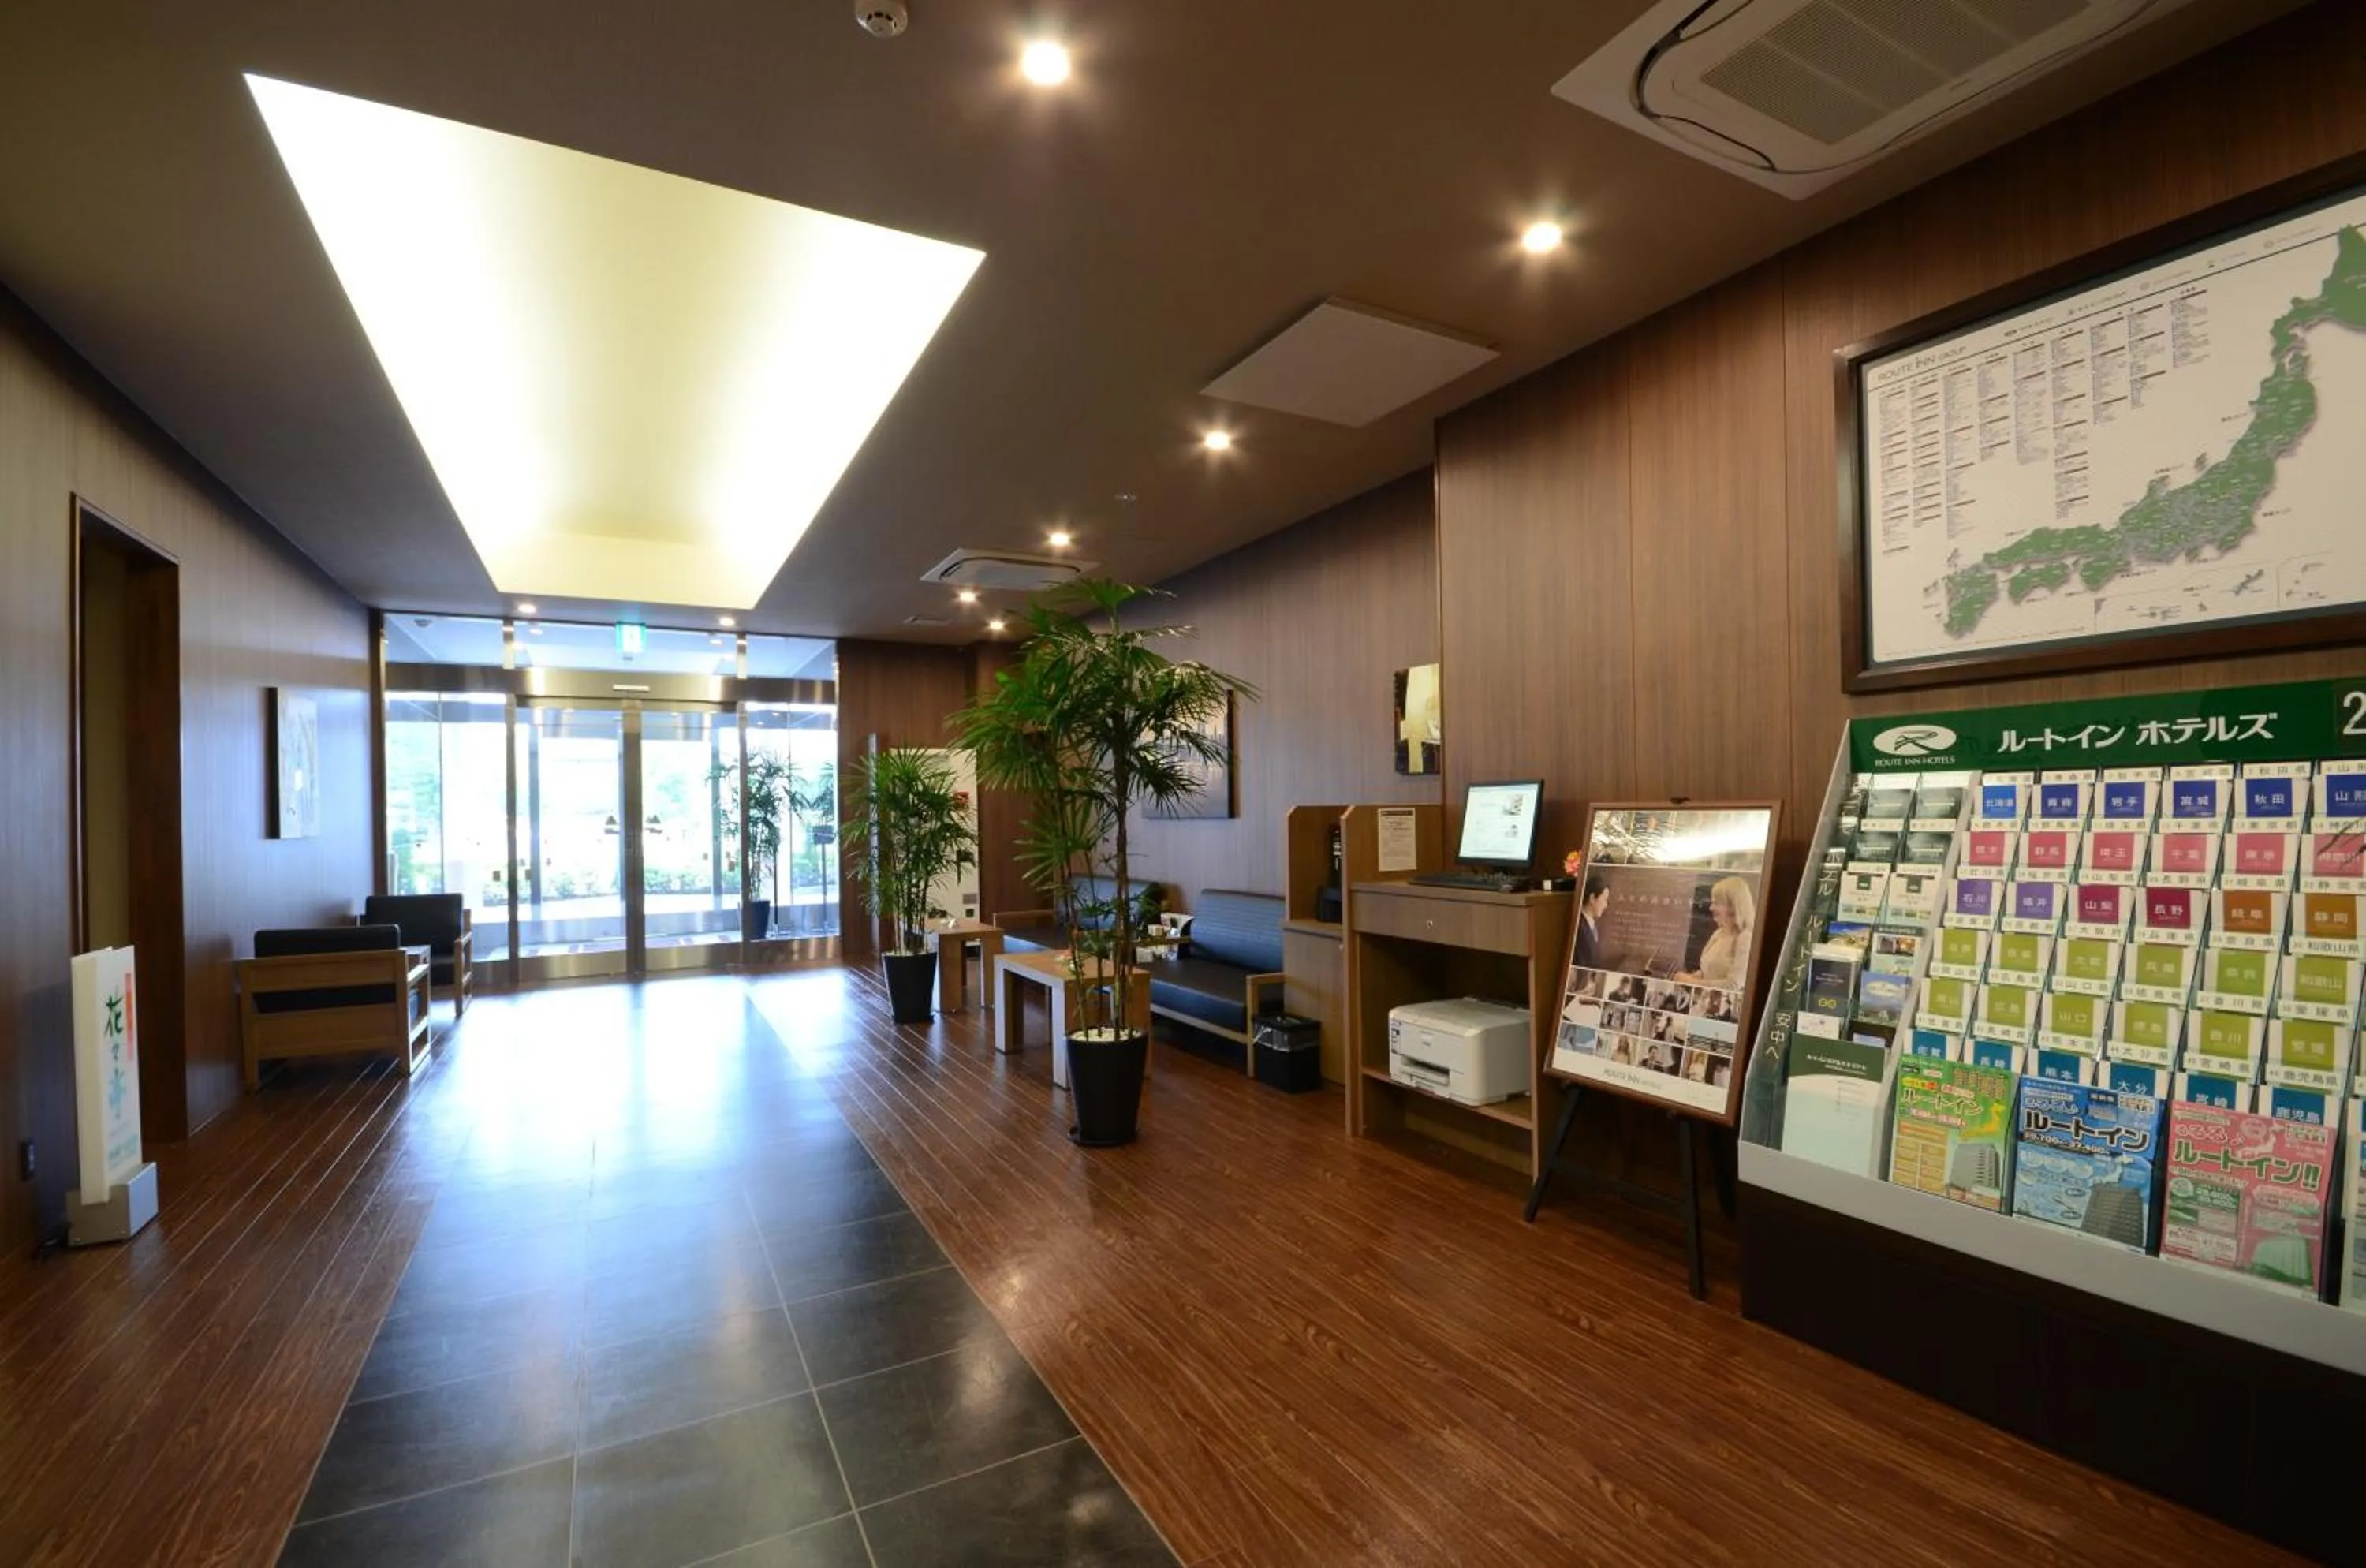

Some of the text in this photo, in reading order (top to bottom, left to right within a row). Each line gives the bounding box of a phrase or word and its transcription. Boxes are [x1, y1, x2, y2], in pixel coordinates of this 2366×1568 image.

[1878, 364, 1913, 381] ROUTE
[1997, 712, 2278, 753] ルートイン ホテルズ
[1875, 755, 1955, 767] ROUTE INN HOTELS
[2254, 793, 2285, 805] 秋田
[2084, 900, 2114, 911] 山梨
[2154, 904, 2184, 916] 長野
[1785, 914, 1823, 992] ルートイン
[2059, 1010, 2087, 1023] 山口
[2044, 1066, 2073, 1080] 熊本
[2116, 1080, 2148, 1095] 大分
[1902, 1088, 1984, 1116] ルートイン
[2025, 1107, 2149, 1151] ルートイン
[2173, 1138, 2321, 1191] ルートイン!!
